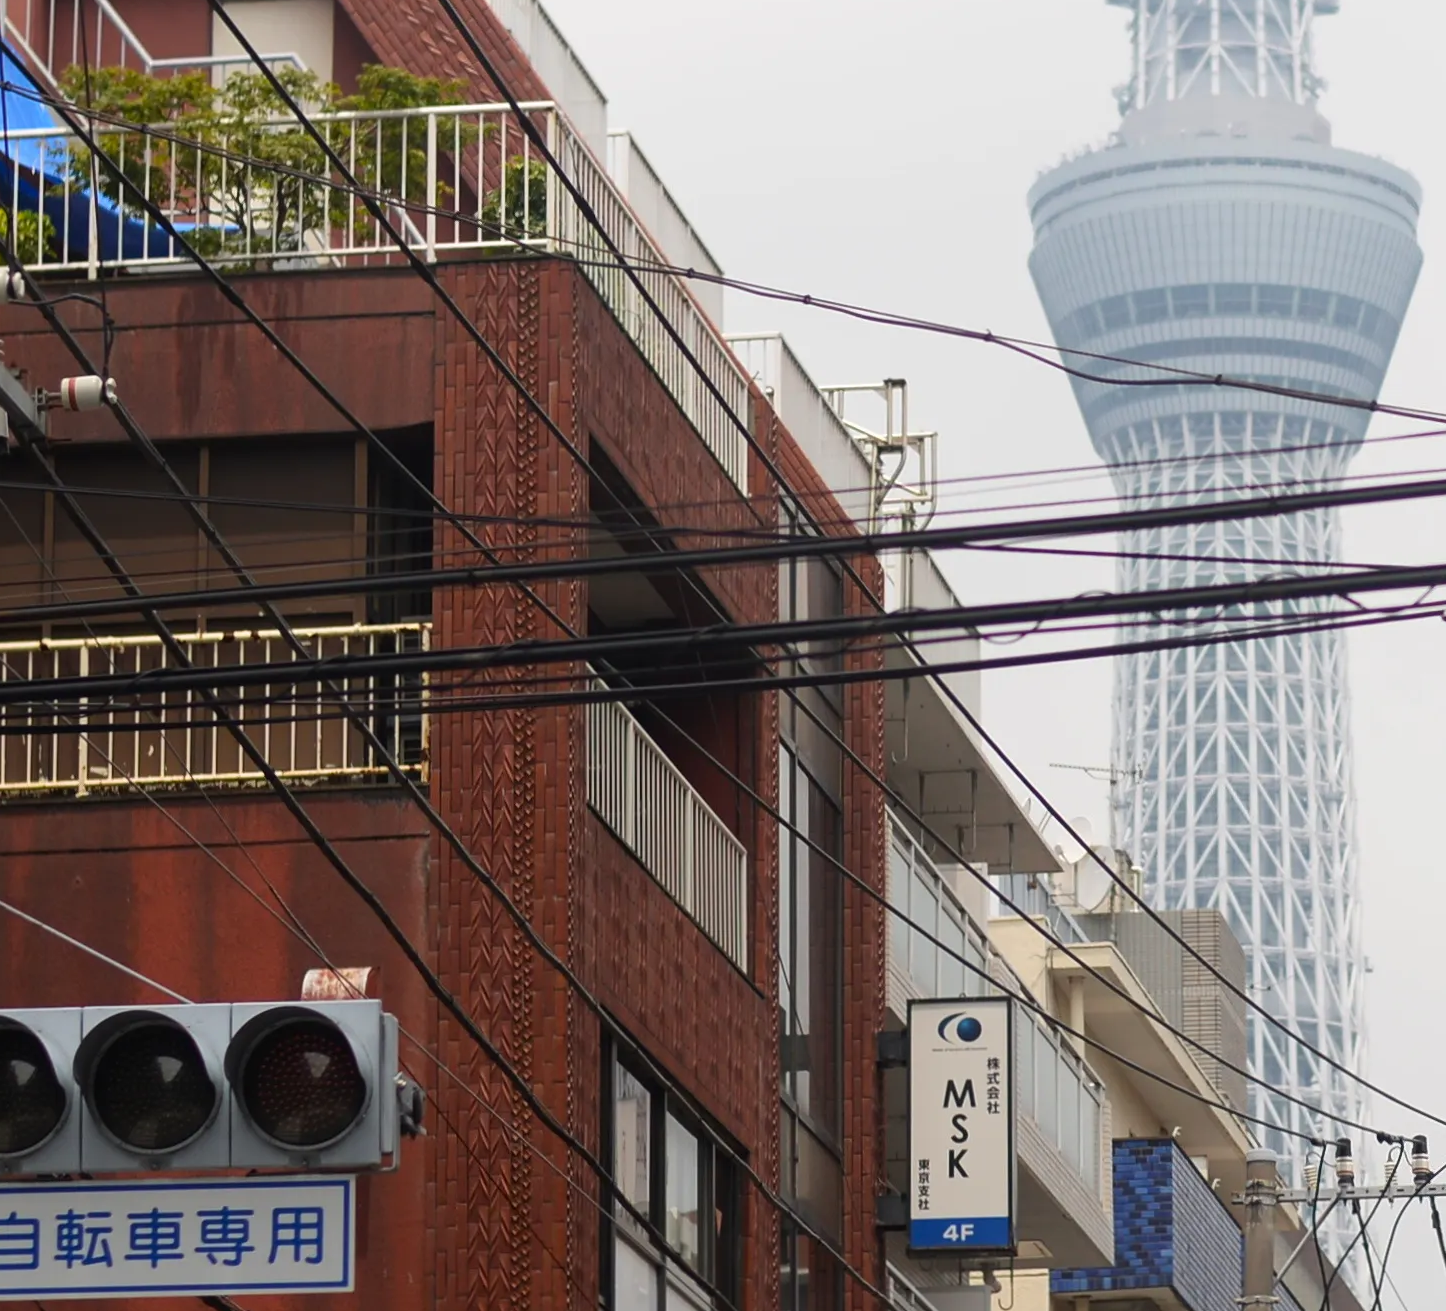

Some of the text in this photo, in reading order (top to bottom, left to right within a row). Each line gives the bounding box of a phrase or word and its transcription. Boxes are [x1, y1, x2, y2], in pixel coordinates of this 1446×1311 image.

[986, 1056, 1001, 1115] 株式会社
[917, 1158, 931, 1211] 東京支社
[942, 1224, 975, 1243] 4F
